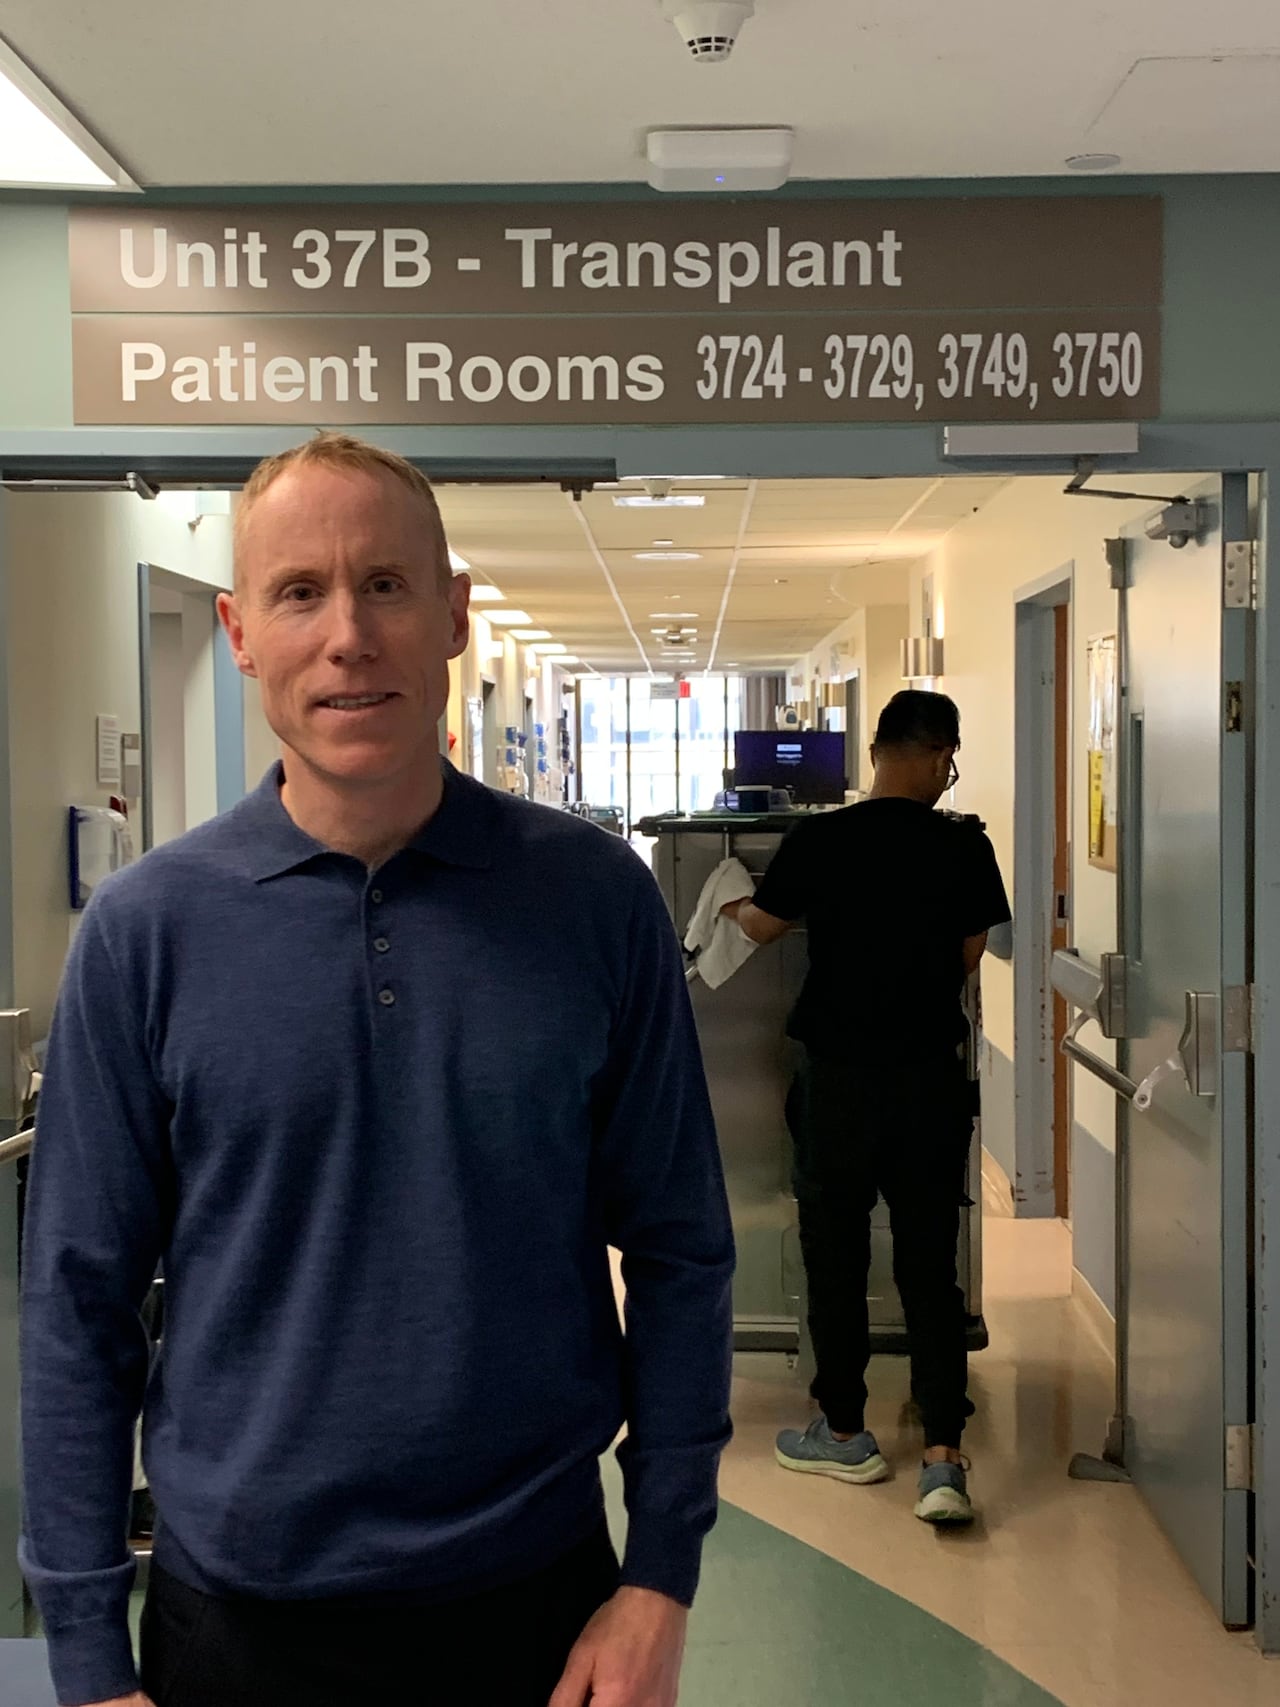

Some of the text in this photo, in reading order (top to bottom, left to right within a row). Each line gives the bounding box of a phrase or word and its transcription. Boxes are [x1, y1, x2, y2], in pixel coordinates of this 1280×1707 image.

[119, 227, 903, 304] Unit 37B - Transplant
[120, 331, 1143, 411] Patient Rooms 3724 - 3729, 3749, 3750
